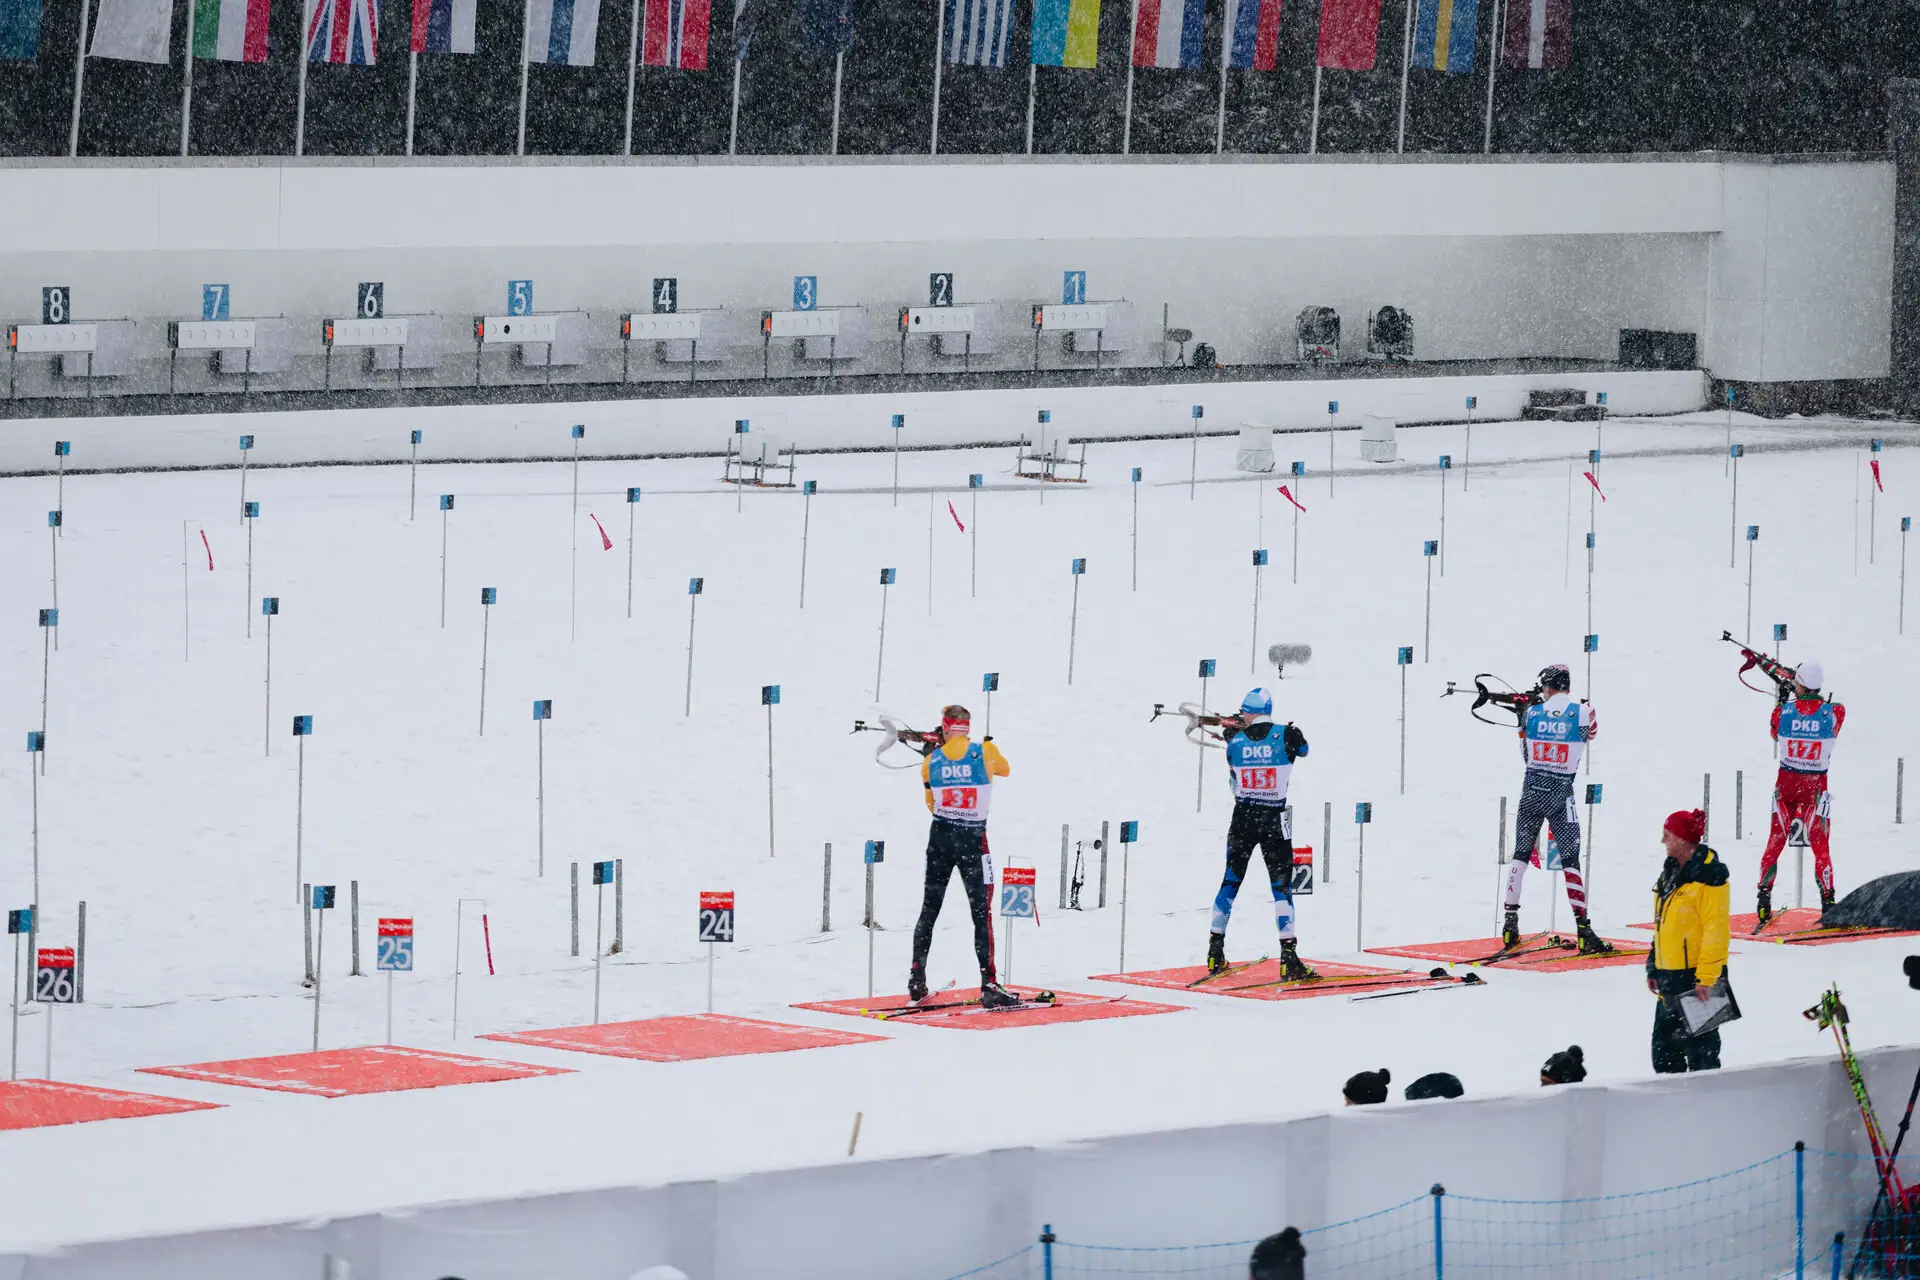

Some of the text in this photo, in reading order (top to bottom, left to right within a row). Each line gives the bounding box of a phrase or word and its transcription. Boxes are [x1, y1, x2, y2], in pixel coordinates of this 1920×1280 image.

[210, 287, 223, 320] 7
[363, 285, 377, 317] 6
[513, 281, 527, 314] 5
[658, 279, 671, 311] 4
[799, 277, 812, 310] 3
[936, 275, 949, 306] 2
[1071, 273, 1079, 304] 1
[49, 288, 63, 321] 8
[1537, 721, 1567, 734] DKB
[1791, 719, 1820, 731] DKB
[1242, 745, 1272, 759] DKB
[941, 765, 972, 779] DKB
[1508, 867, 1518, 892] USA
[1001, 886, 1033, 916] 23
[700, 909, 732, 940] 24
[379, 937, 412, 969] 25
[38, 967, 73, 1001] 26
